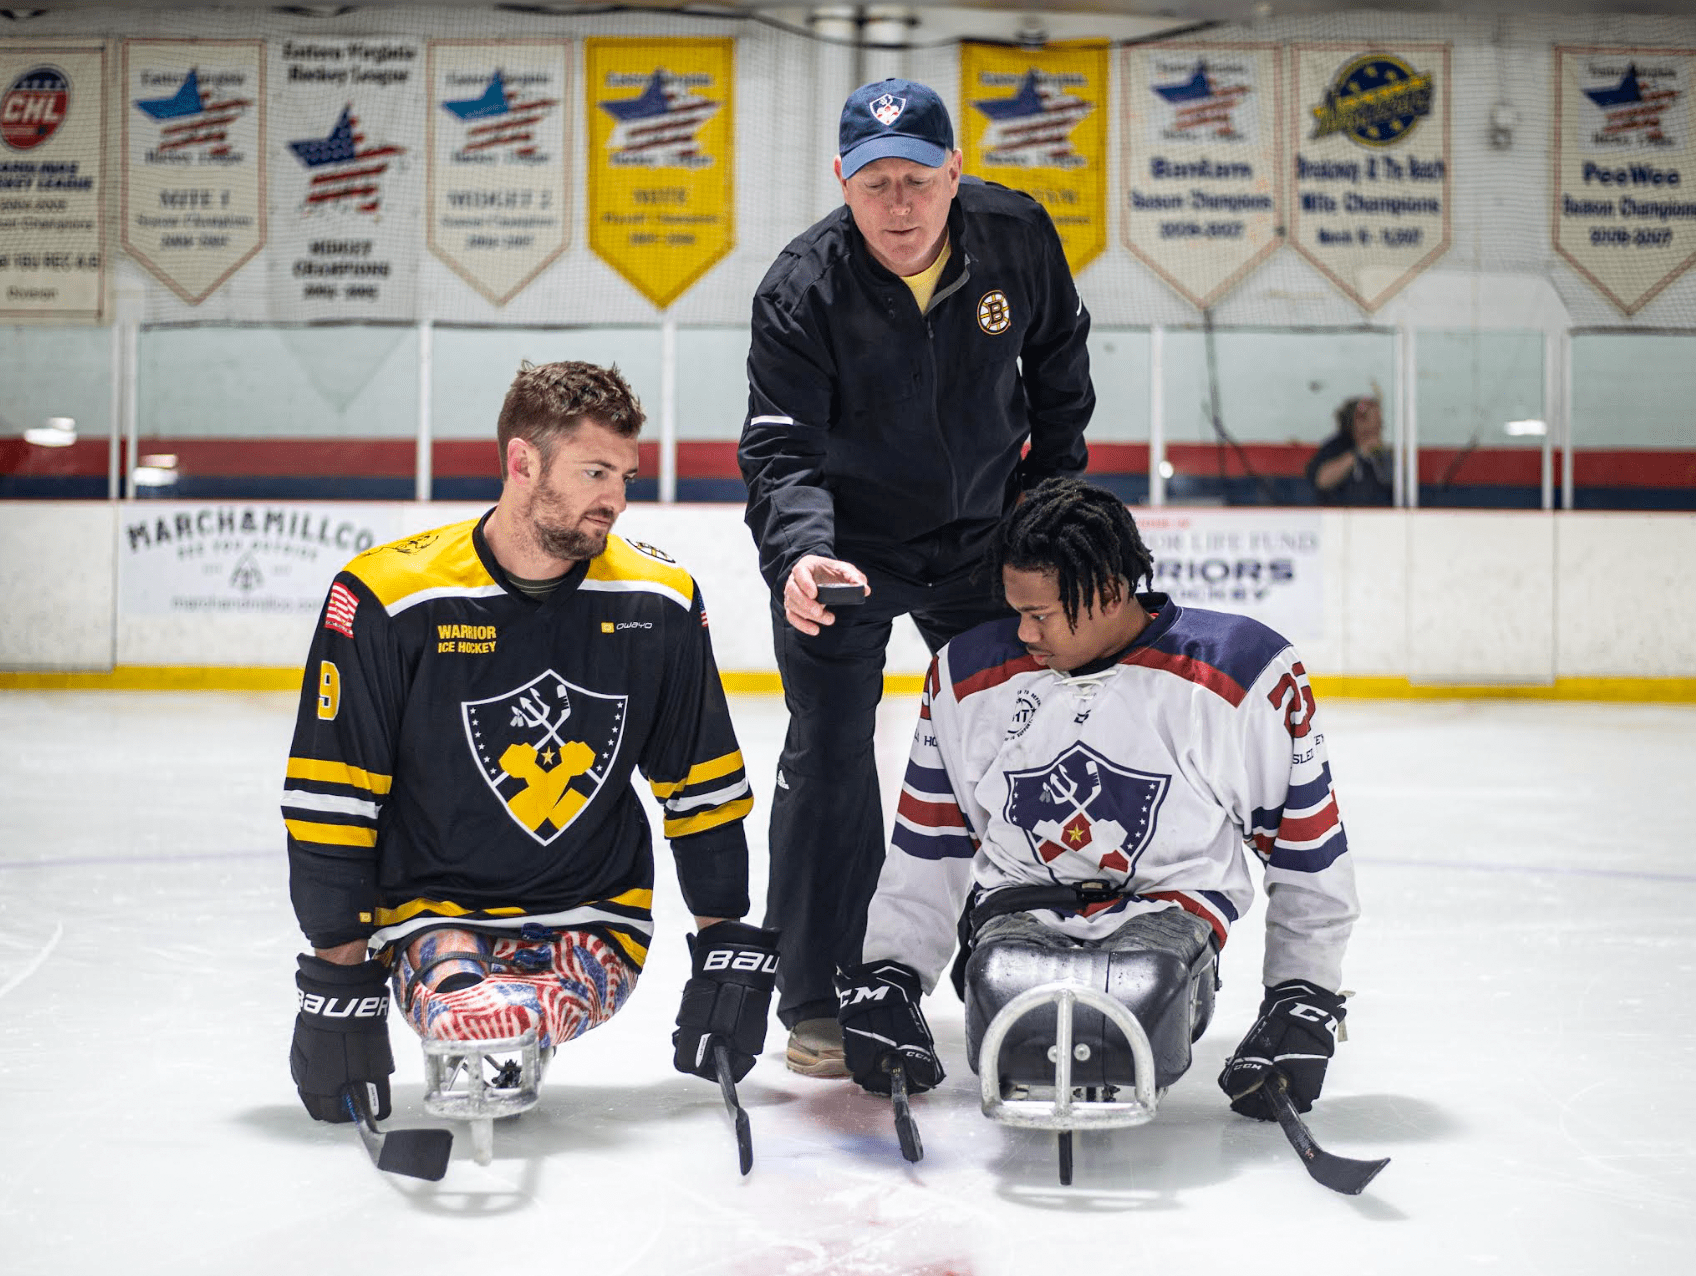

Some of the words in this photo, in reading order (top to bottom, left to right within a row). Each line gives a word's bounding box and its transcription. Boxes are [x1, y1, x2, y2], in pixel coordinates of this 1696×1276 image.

[1157, 556, 1295, 583] RIORS
[437, 624, 497, 640] WARRIOR
[438, 641, 455, 653] ICE
[458, 640, 497, 654] HOCKEY
[316, 660, 341, 721] 9
[703, 950, 780, 974] BAU
[838, 985, 891, 1009] CM
